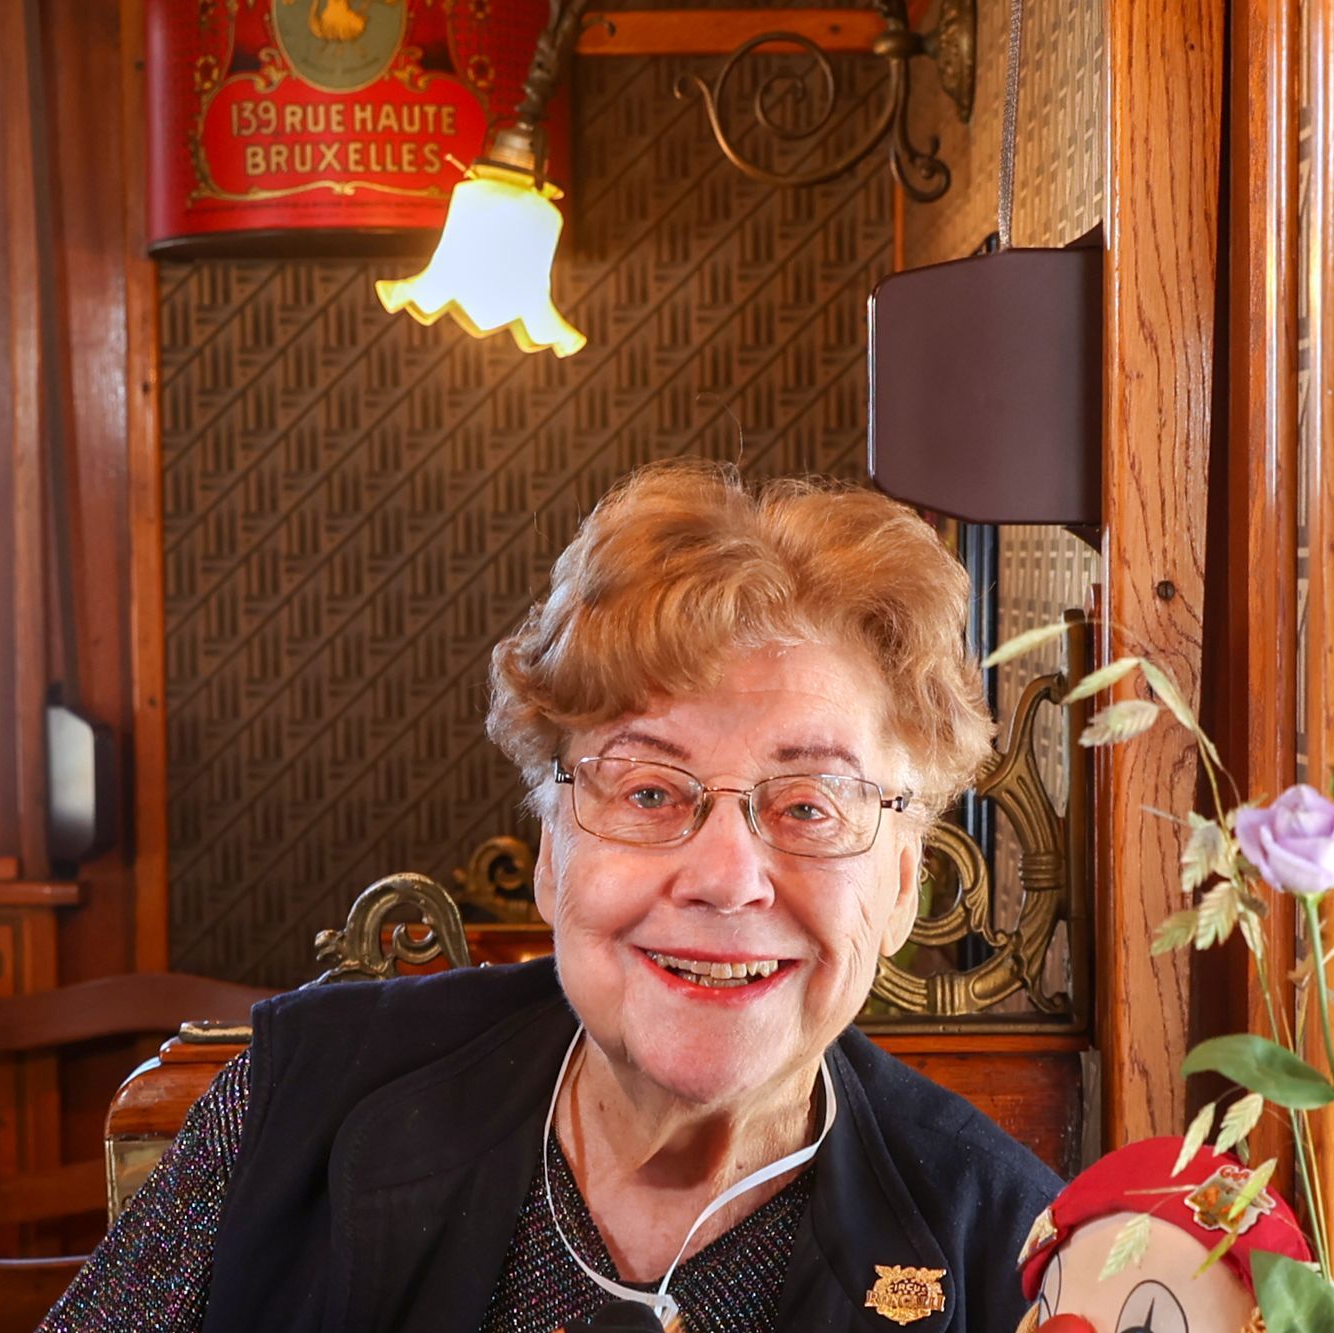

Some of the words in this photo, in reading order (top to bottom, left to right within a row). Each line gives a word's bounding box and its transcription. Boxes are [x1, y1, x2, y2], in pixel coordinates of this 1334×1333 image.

[230, 102, 278, 137] 139
[284, 104, 346, 134] RUE
[354, 103, 456, 137] HAUTE
[245, 141, 442, 176] BRUXELLES
